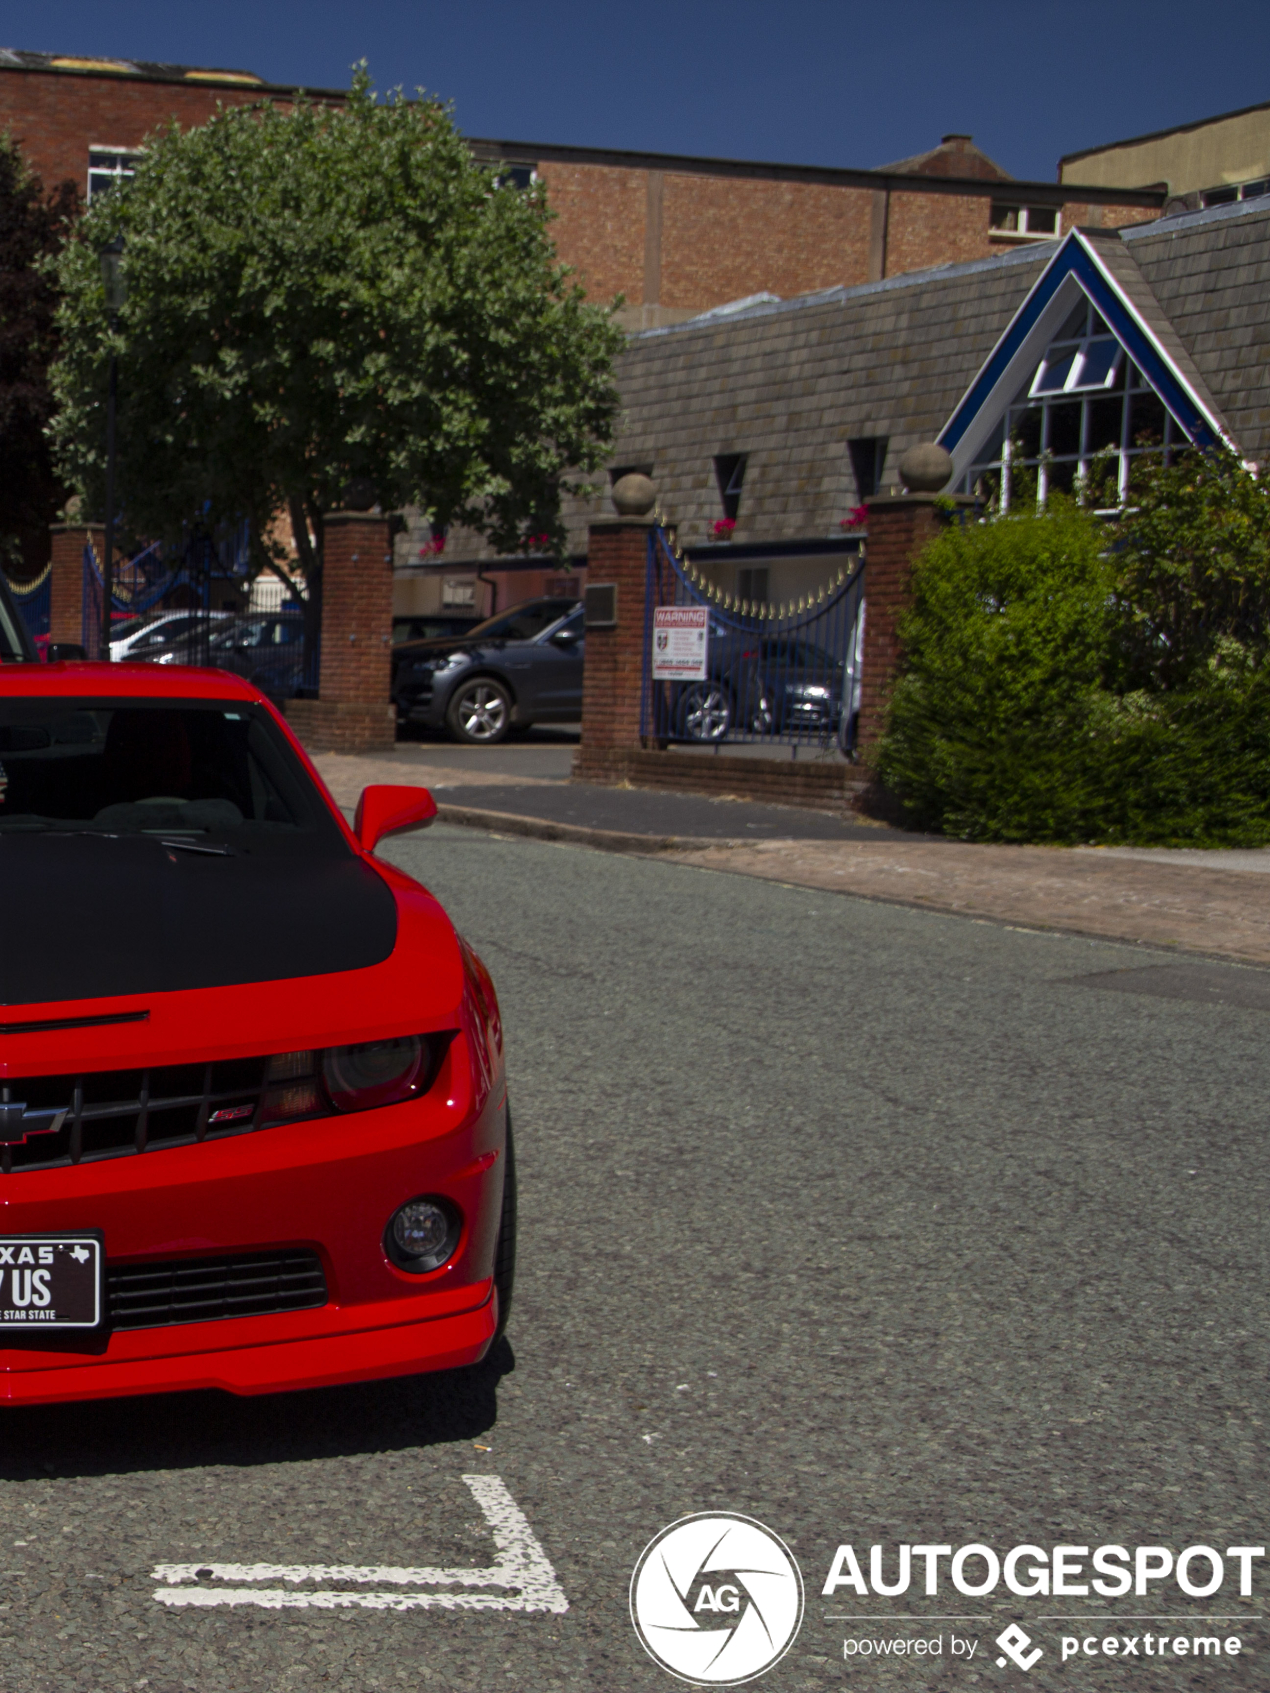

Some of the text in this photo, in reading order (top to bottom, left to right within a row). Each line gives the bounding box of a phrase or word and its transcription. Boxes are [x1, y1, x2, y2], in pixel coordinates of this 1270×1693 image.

[656, 611, 705, 623] WARNING
[11, 1268, 52, 1307] US
[3, 1310, 27, 1321] STAR
[28, 1309, 56, 1320] STATE
